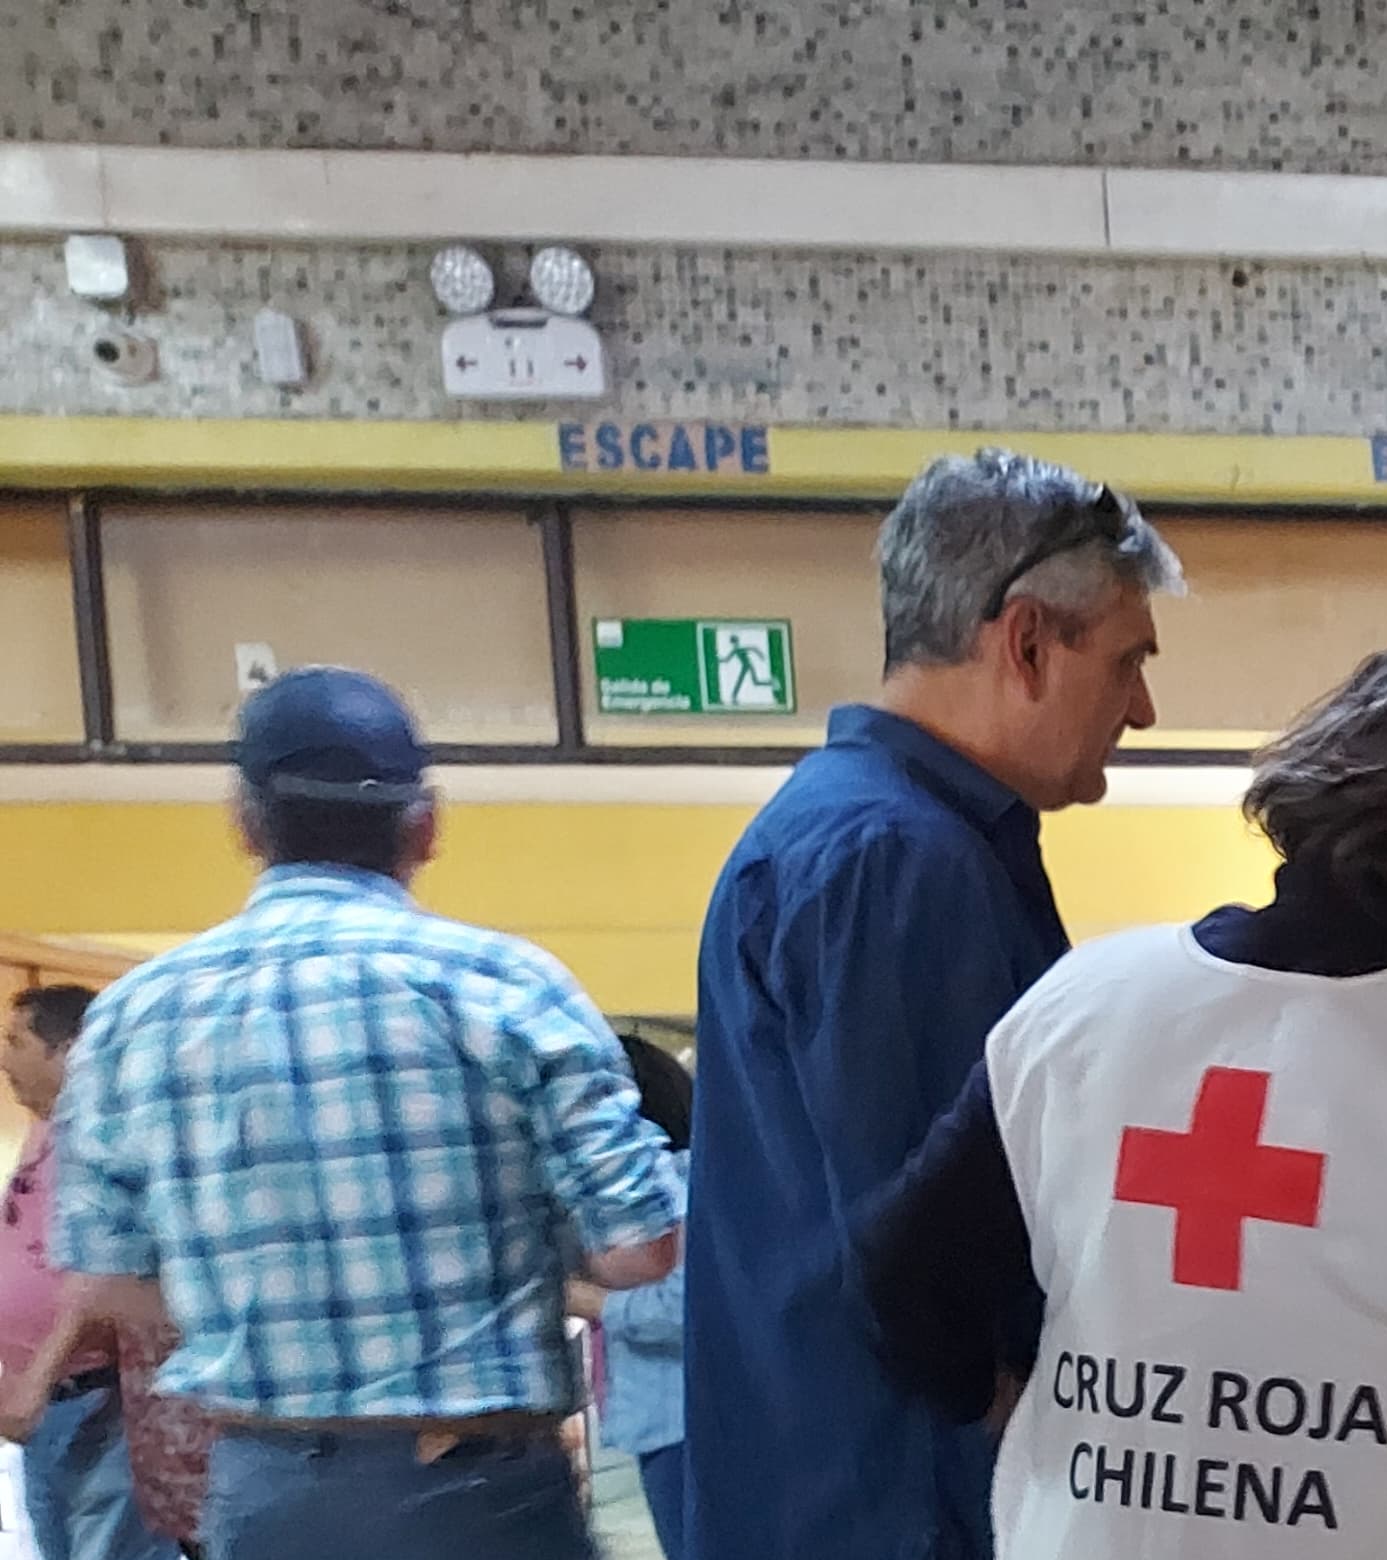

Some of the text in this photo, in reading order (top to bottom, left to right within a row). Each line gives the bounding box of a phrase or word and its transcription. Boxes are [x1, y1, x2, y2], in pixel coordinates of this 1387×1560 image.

[559, 422, 769, 473] ESCAPE
[1054, 1351, 1186, 1424] CRUZ
[1069, 1442, 1338, 1529] CHILENA
